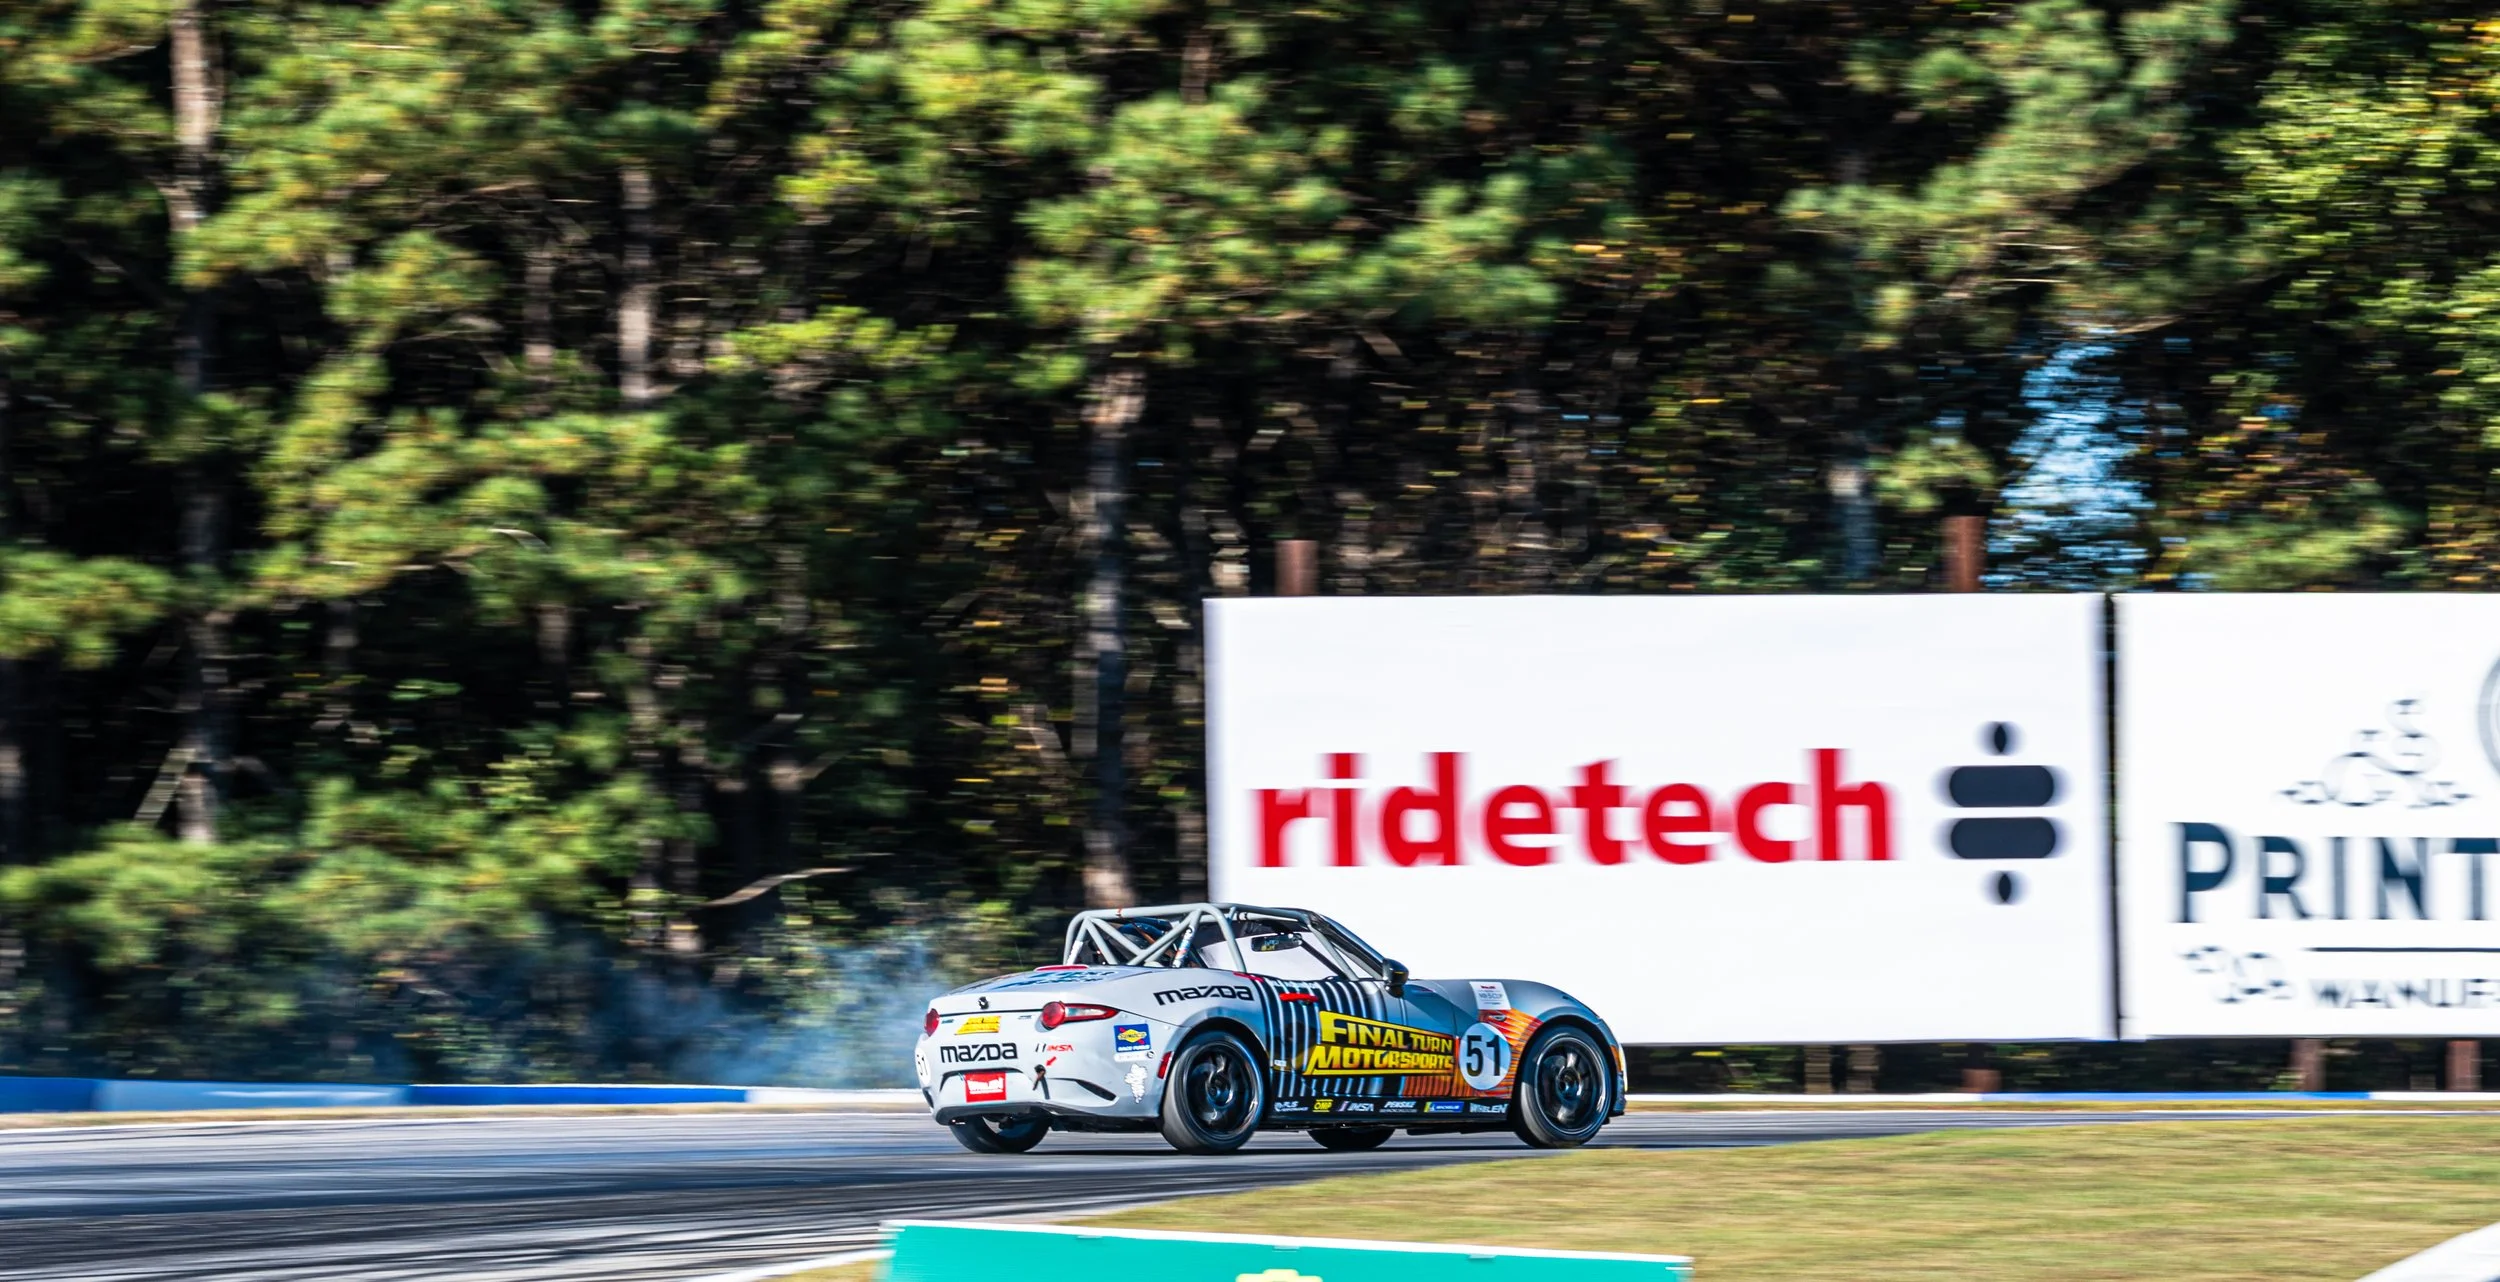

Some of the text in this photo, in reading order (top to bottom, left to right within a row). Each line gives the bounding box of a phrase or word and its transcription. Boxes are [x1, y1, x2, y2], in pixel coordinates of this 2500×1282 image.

[1250, 749, 1898, 867] ridetech
[2168, 822, 2500, 923] PRINT
[1319, 1011, 1453, 1053] FINAL TURN
[1303, 1045, 1454, 1070] MOTORSPORTS
[1466, 1035, 1501, 1077] 51
